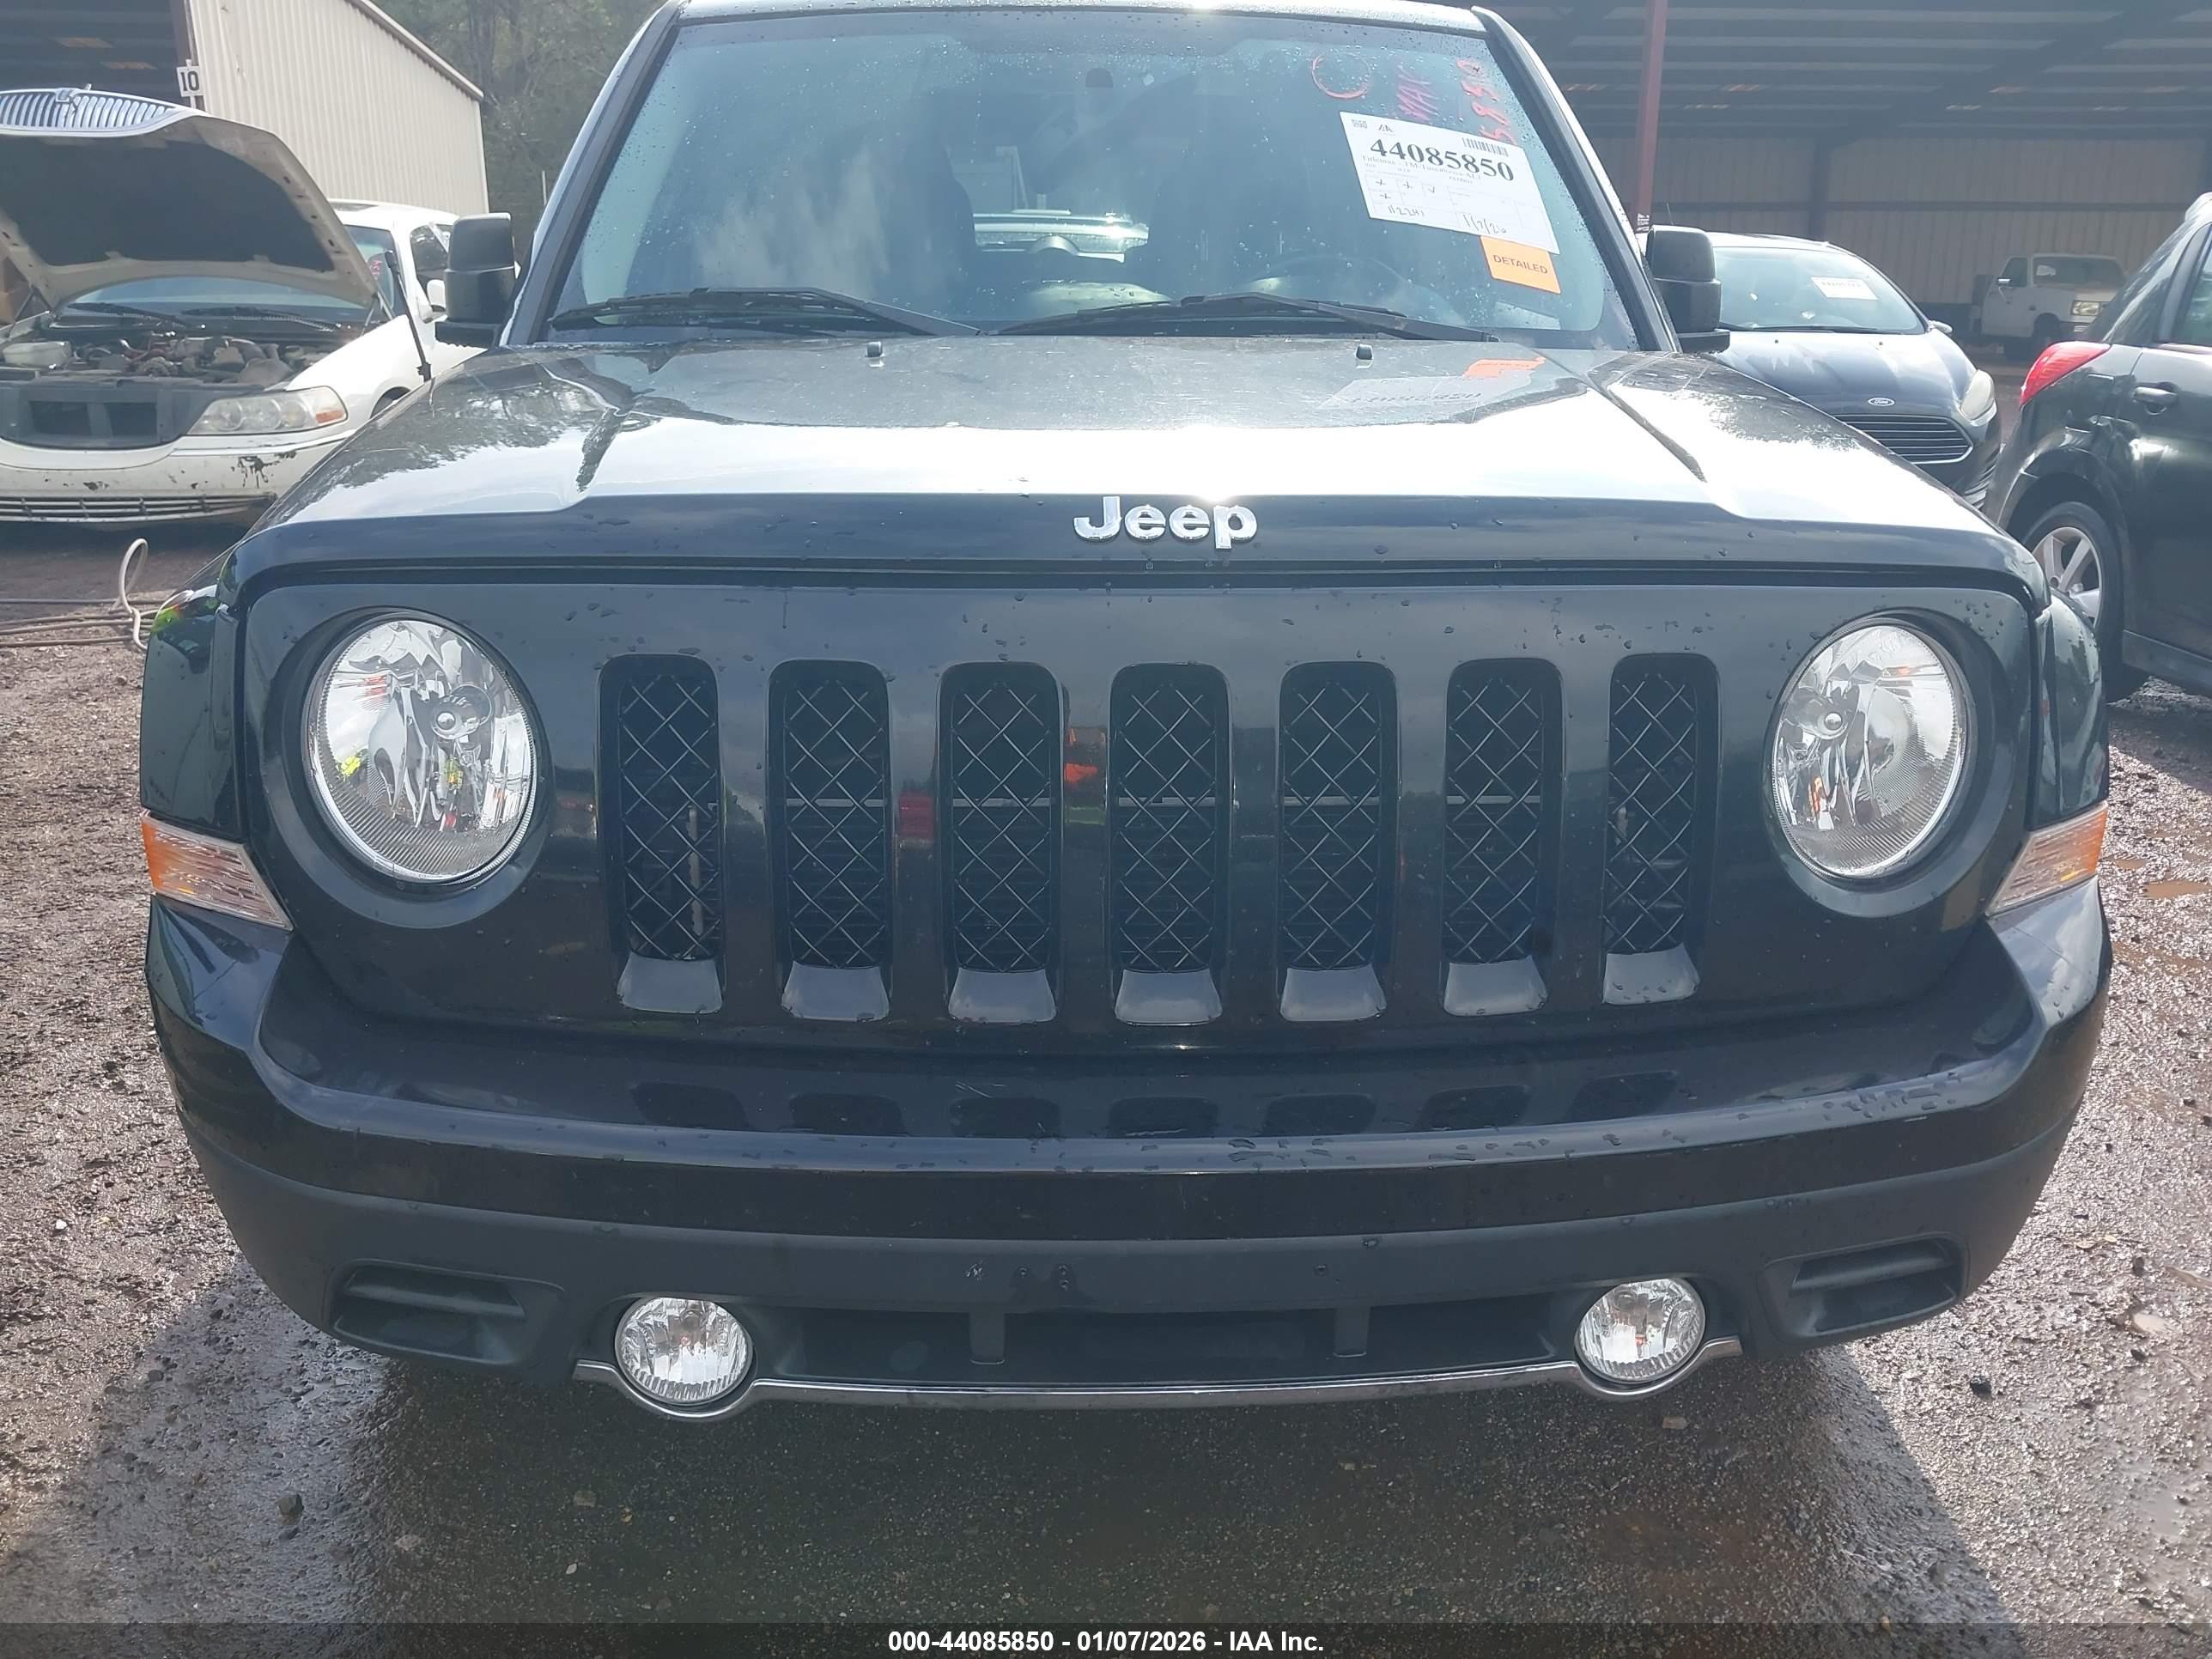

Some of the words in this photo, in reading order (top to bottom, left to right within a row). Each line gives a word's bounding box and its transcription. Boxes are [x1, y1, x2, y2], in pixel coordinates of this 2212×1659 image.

[180, 70, 199, 92] 10
[1370, 138, 1515, 182] 44085850
[1492, 254, 1548, 274] DETAILED
[1073, 495, 1257, 550] Jeep
